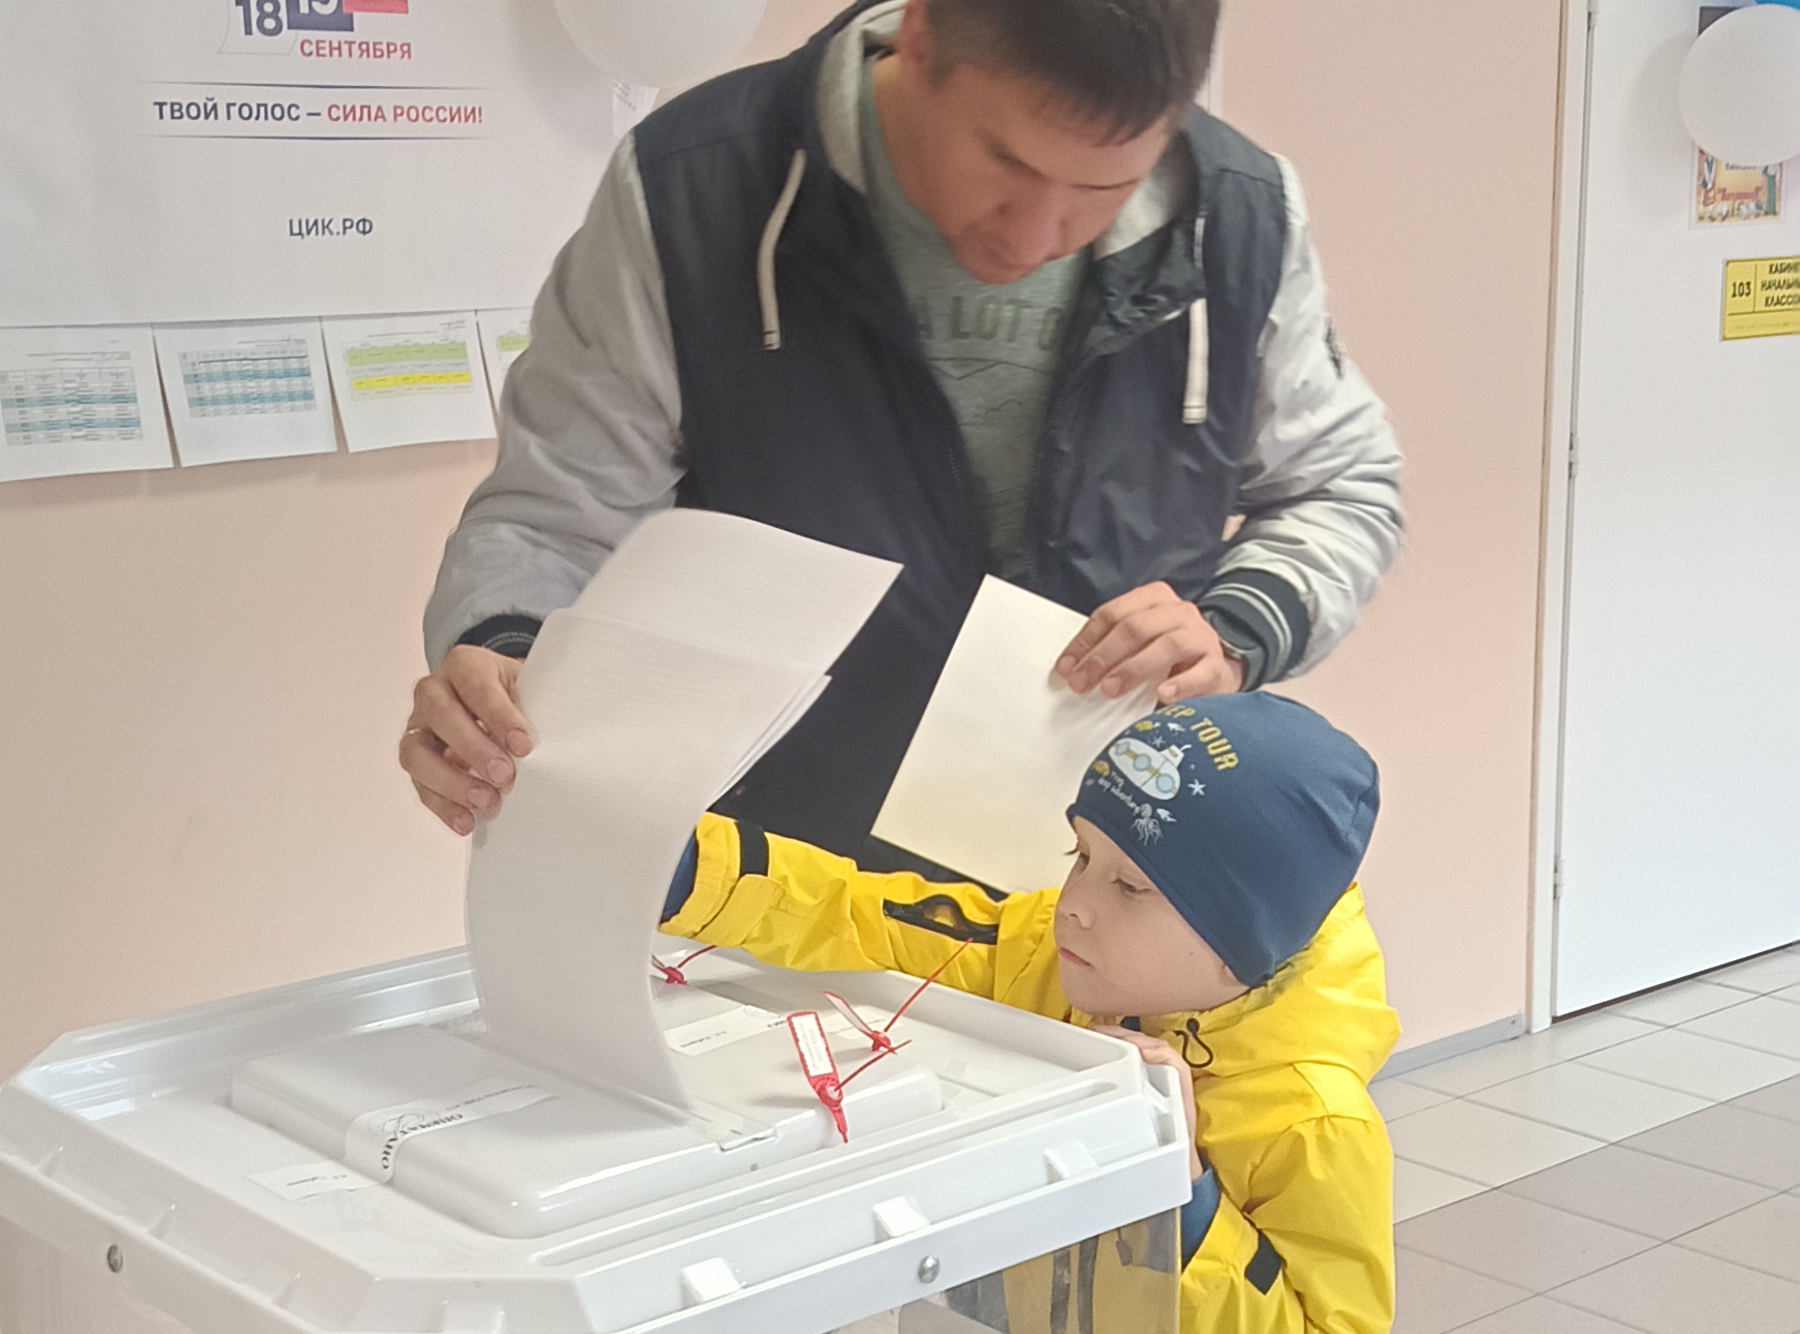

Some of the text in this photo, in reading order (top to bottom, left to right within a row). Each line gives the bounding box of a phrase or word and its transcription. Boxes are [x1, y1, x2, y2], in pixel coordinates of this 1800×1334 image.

[300, 39, 412, 60] СЕНТЯБРЯ
[153, 97, 218, 121] ТВОЙ
[225, 103, 301, 122] ГОЛОС
[327, 104, 387, 123] СИЛА
[393, 105, 483, 124] РОССИИ!
[288, 217, 373, 239] ЦИК.РФ
[1731, 281, 1752, 298] 103
[951, 295, 1032, 344] LOT
[1190, 717, 1239, 771] TOUR
